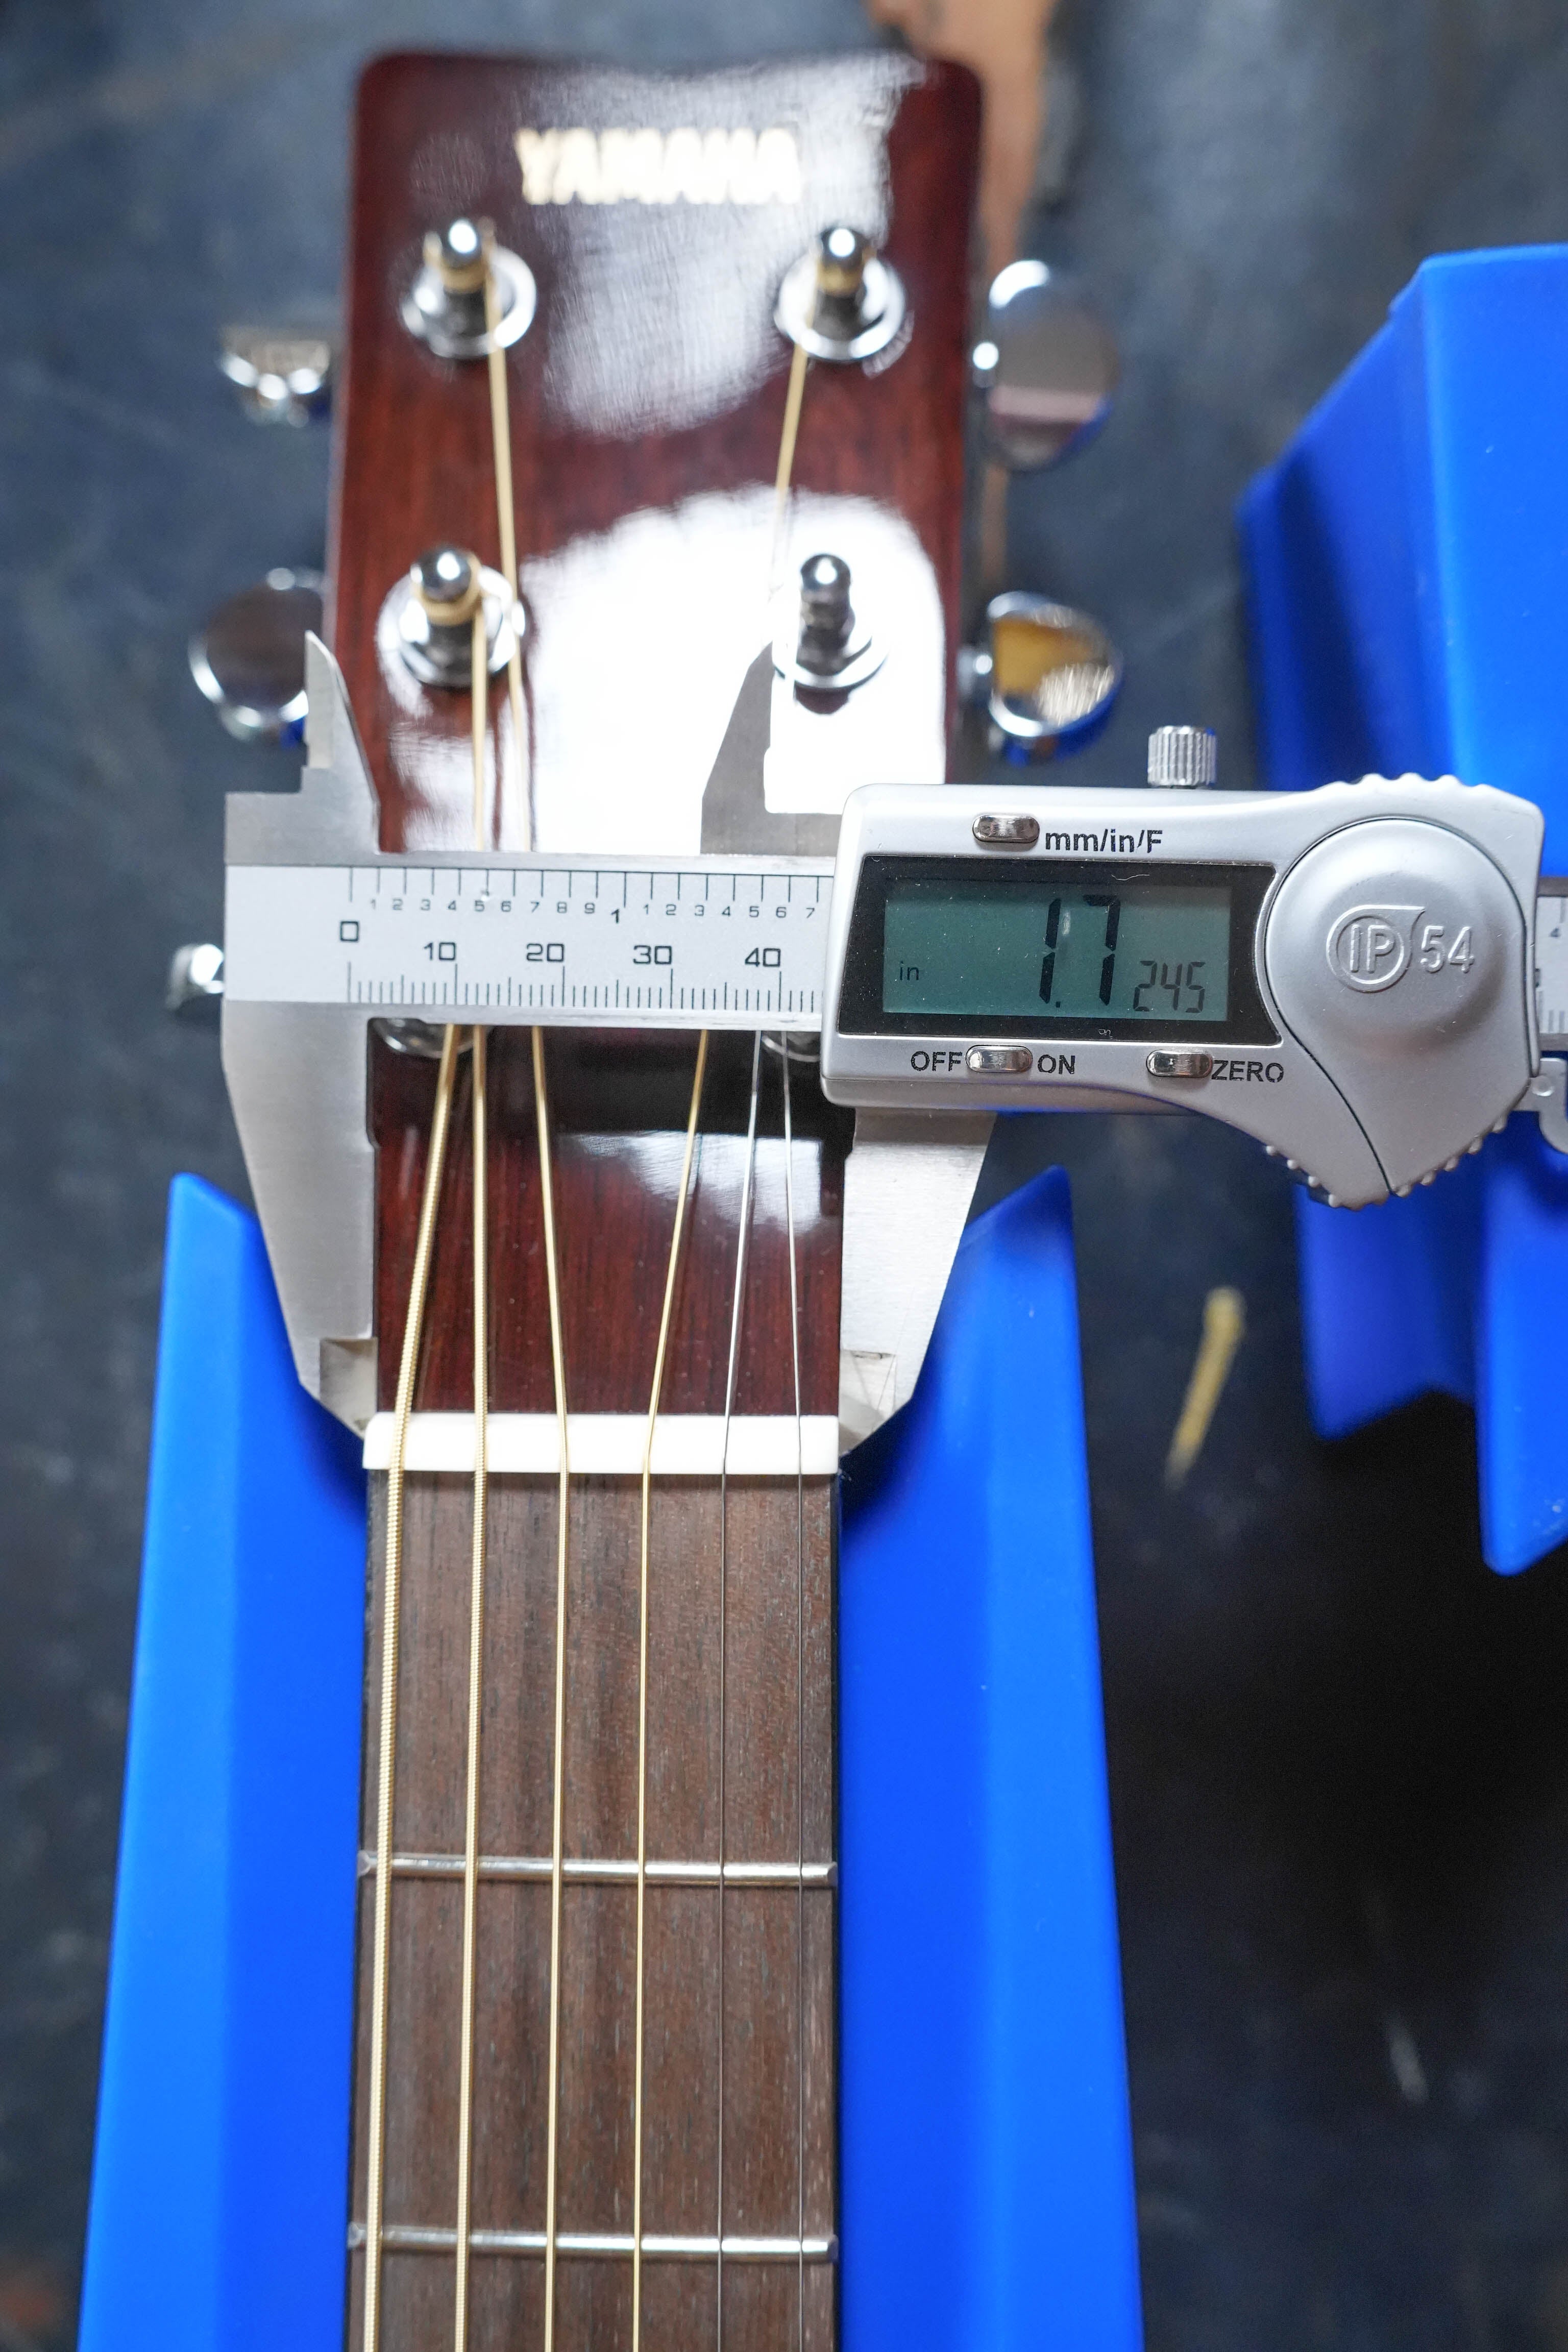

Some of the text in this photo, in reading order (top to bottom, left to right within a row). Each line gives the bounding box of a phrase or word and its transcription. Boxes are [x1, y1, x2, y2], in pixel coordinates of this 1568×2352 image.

[513, 127, 802, 205] YAMAHA
[1045, 828, 1163, 853] mm/in/F
[371, 899, 815, 923] 1 2 3 4 5 6 7 8 9 1 1 2 3 4 5 6 7
[340, 921, 781, 967] 0 10 20 30 40
[1350, 924, 1475, 973] IP 54
[899, 960, 920, 981] in
[911, 1051, 1075, 1074] OFF ON
[1212, 1060, 1284, 1083] ZERO
